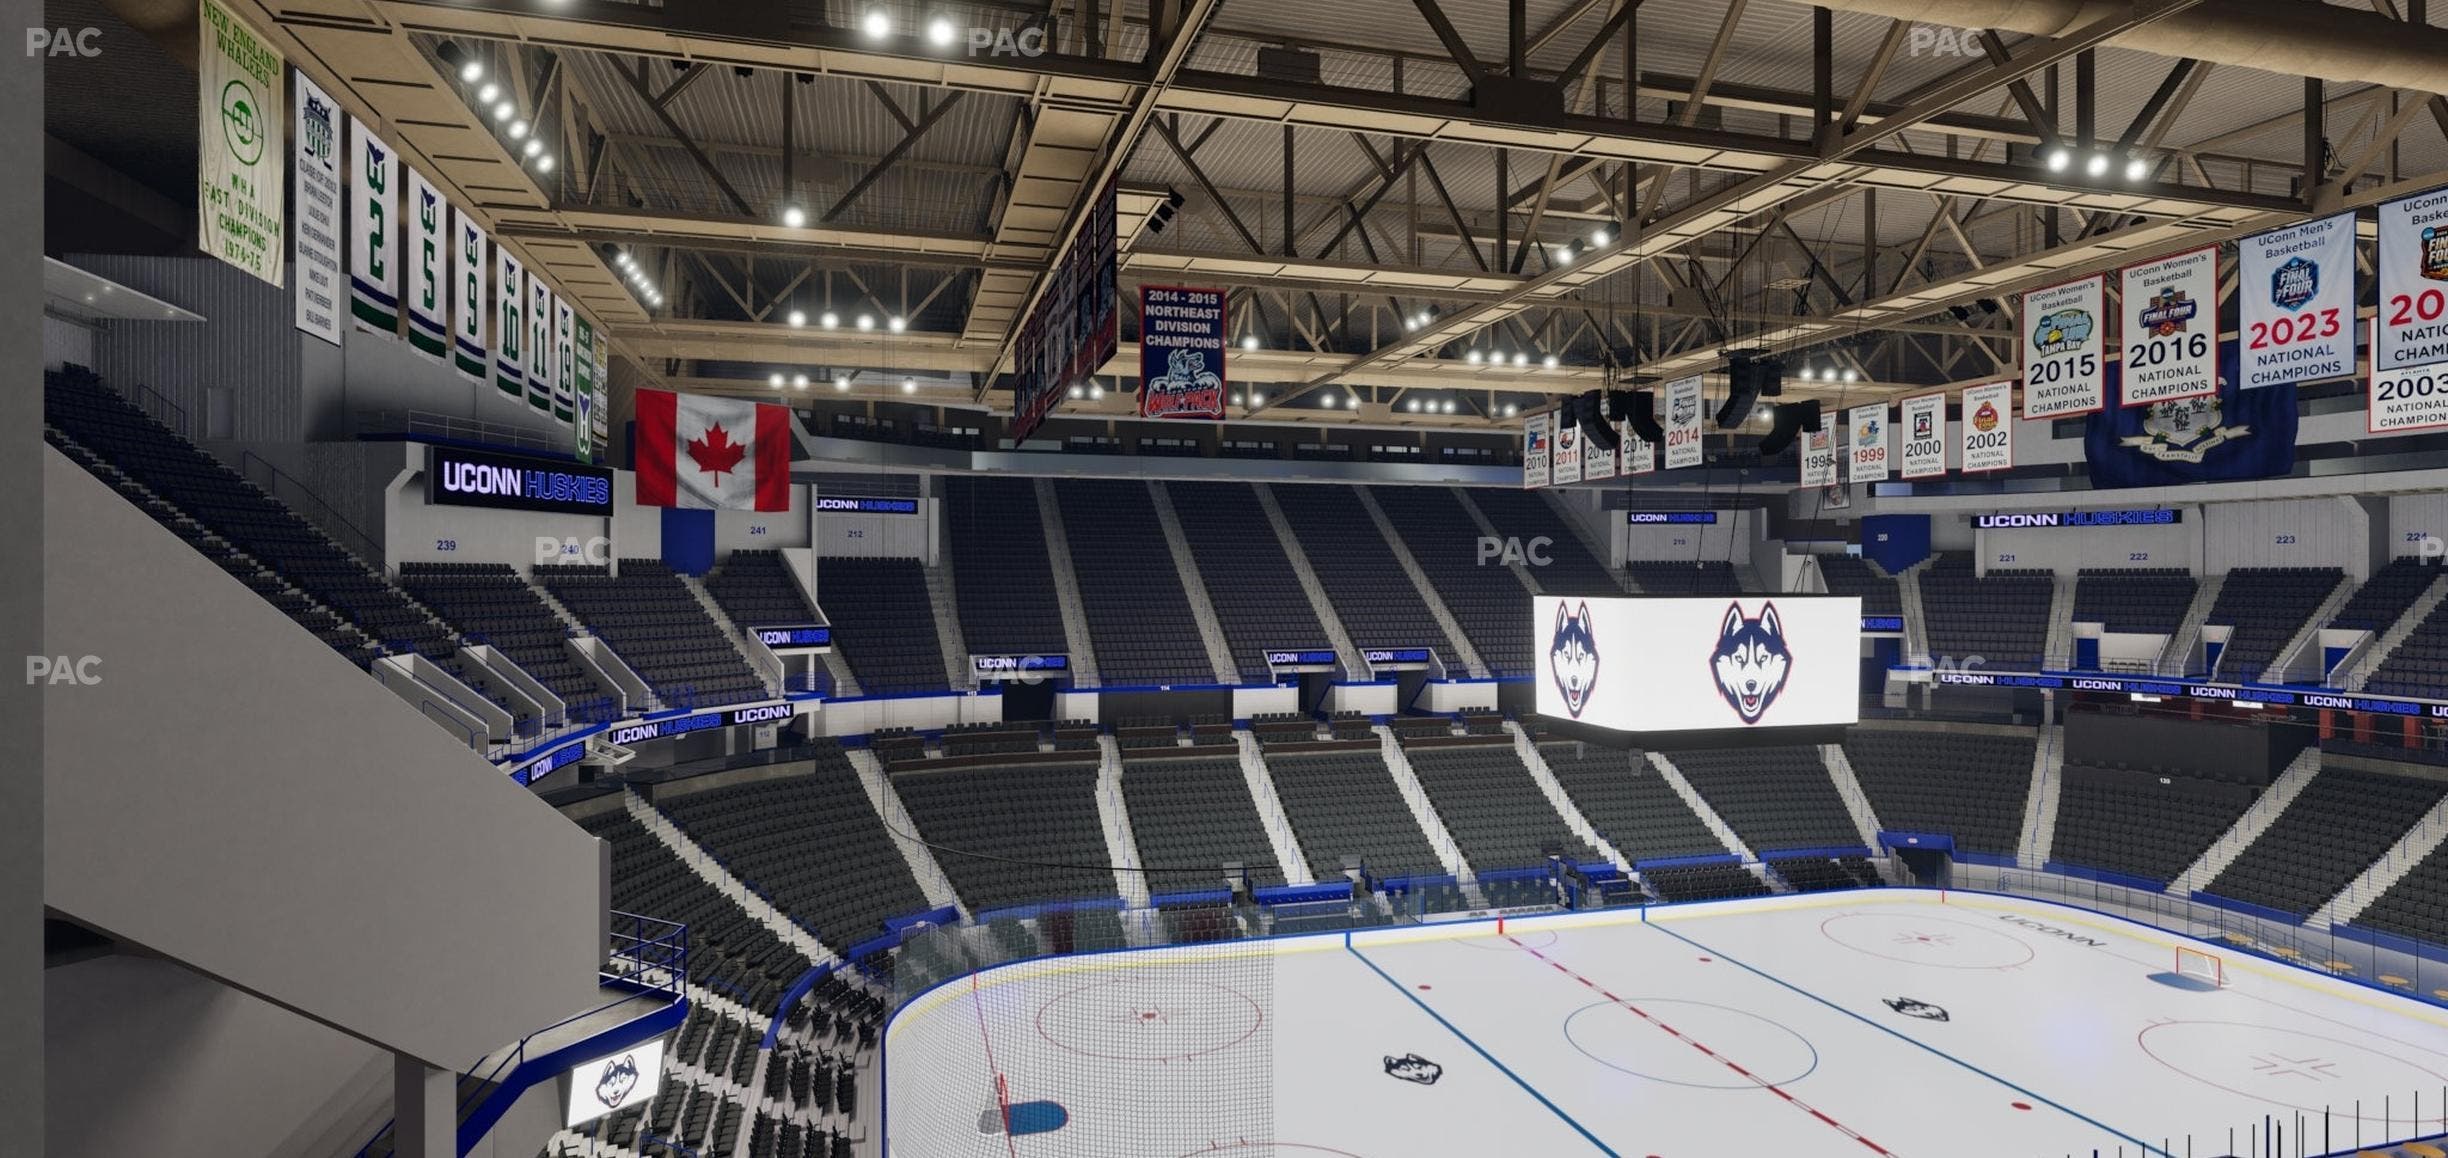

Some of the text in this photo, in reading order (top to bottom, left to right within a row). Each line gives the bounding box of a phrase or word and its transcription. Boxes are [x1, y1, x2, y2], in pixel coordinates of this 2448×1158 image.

[204, 0, 279, 76] NEW ENGLAND
[217, 29, 269, 88] WHALERS
[2403, 195, 2447, 212] UConn
[239, 199, 279, 238] DIVISION
[220, 213, 266, 251] CHAMPIONS
[369, 197, 384, 281] 2
[2258, 221, 2333, 247] UConn Men's
[2265, 236, 2325, 259] Basketball
[424, 238, 435, 311] 5
[2130, 254, 2207, 279] UConn Women's
[2143, 270, 2192, 288] Basketball
[2280, 268, 2310, 286] FINAL
[1149, 290, 1178, 302] 2014
[1189, 293, 1217, 304] 2015
[2030, 281, 2095, 303] UConn Women's
[2282, 279, 2313, 298] FOUR
[467, 272, 477, 337] 9
[1146, 305, 1221, 320] NORTHEAST
[2041, 296, 2083, 311] Basketball
[2389, 289, 2445, 326] 20
[2144, 305, 2192, 323] FINAL FOUR
[503, 299, 519, 362] 10
[1155, 320, 1211, 334] DIVISION
[2250, 308, 2340, 350] 2023
[533, 321, 546, 378] 11
[1146, 335, 1220, 349] CHAMPIONS
[2041, 340, 2081, 358] TAMPA BAY
[2129, 333, 2207, 369] 2016
[2257, 344, 2335, 366] NATIONAL
[2394, 342, 2448, 361] CHAM
[559, 341, 571, 393] 19
[2030, 353, 2095, 386] 2015
[2138, 365, 2201, 383] NATIONAL
[2251, 361, 2342, 384] CHAMPIONS
[2037, 382, 2091, 399] NATIONAL
[2132, 379, 2208, 399] CHAMPIONS
[2032, 396, 2096, 414] CHAMPIONS
[2387, 400, 2448, 413] NATIONAL
[2380, 412, 2447, 427] CHAMPION
[1668, 427, 1699, 446] 2014
[1967, 431, 2007, 450] 2002
[1555, 449, 1578, 465] 2011
[1853, 447, 1885, 463] 1999
[1905, 440, 1941, 457] 2000
[1971, 451, 2004, 459] NATIONAL
[1526, 455, 1547, 470] 2010
[1856, 464, 1882, 472] NATIONAL
[1906, 466, 1942, 475] CHAMPIONS
[1909, 458, 1939, 466] NATIONAL
[1967, 459, 2007, 469] CHAMPIONS
[444, 461, 609, 505] UCONN HUSKIES
[1853, 472, 1885, 480] CHAMPIONS
[816, 499, 858, 510] UCONN
[1631, 513, 1667, 522] UCONN
[1979, 510, 2173, 528] UCONN HUSKIES
[751, 526, 766, 535] 241
[2276, 535, 2296, 544] 223
[437, 540, 456, 551] 239
[1999, 554, 2015, 562] 221
[2130, 552, 2148, 561] 222
[759, 631, 791, 644] UCONN
[979, 656, 1017, 668] UCONN
[1269, 653, 1298, 663] UCONN
[1366, 652, 1393, 661] UCONN
[1941, 674, 1994, 684] UCONN
[2072, 679, 2121, 691] UCONN
[2190, 686, 2236, 699] UCONN
[2304, 695, 2352, 708] UCONN
[613, 723, 658, 745] UCONN
[734, 705, 791, 723] UCONN
[531, 755, 552, 781] UCONN
[1999, 915, 2108, 946] UCONN
